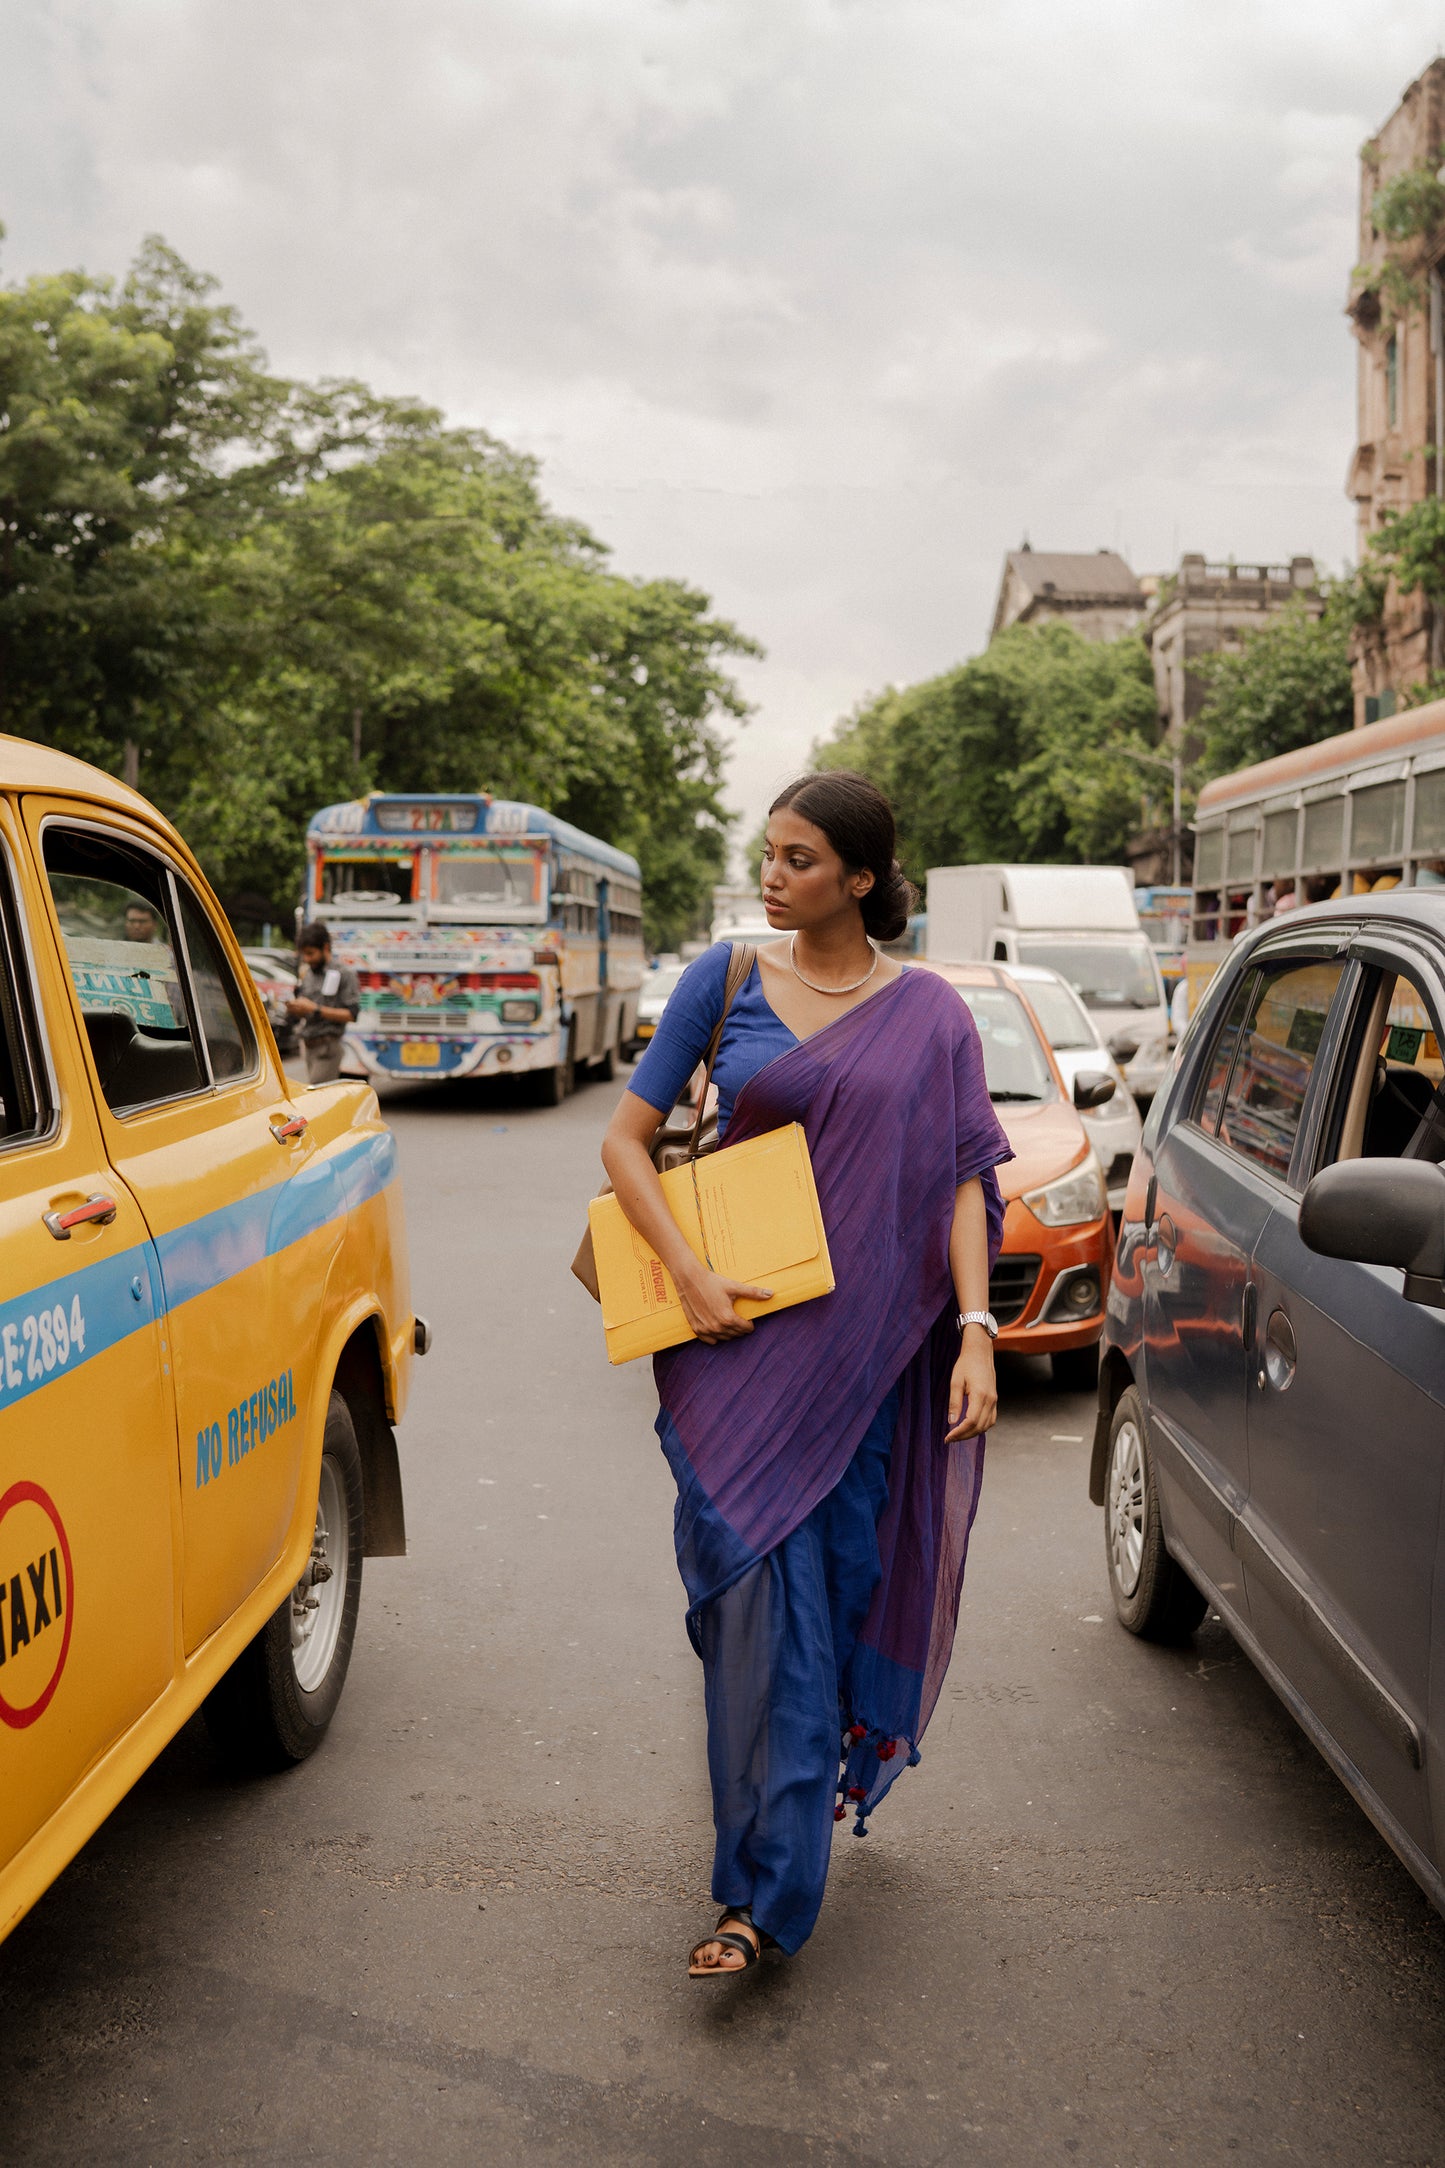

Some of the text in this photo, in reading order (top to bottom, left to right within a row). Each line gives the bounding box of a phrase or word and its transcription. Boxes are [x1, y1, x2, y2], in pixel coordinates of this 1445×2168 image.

[650, 1259, 667, 1303] JAYGURU
[196, 1368, 296, 1489] NO REFUSAL
